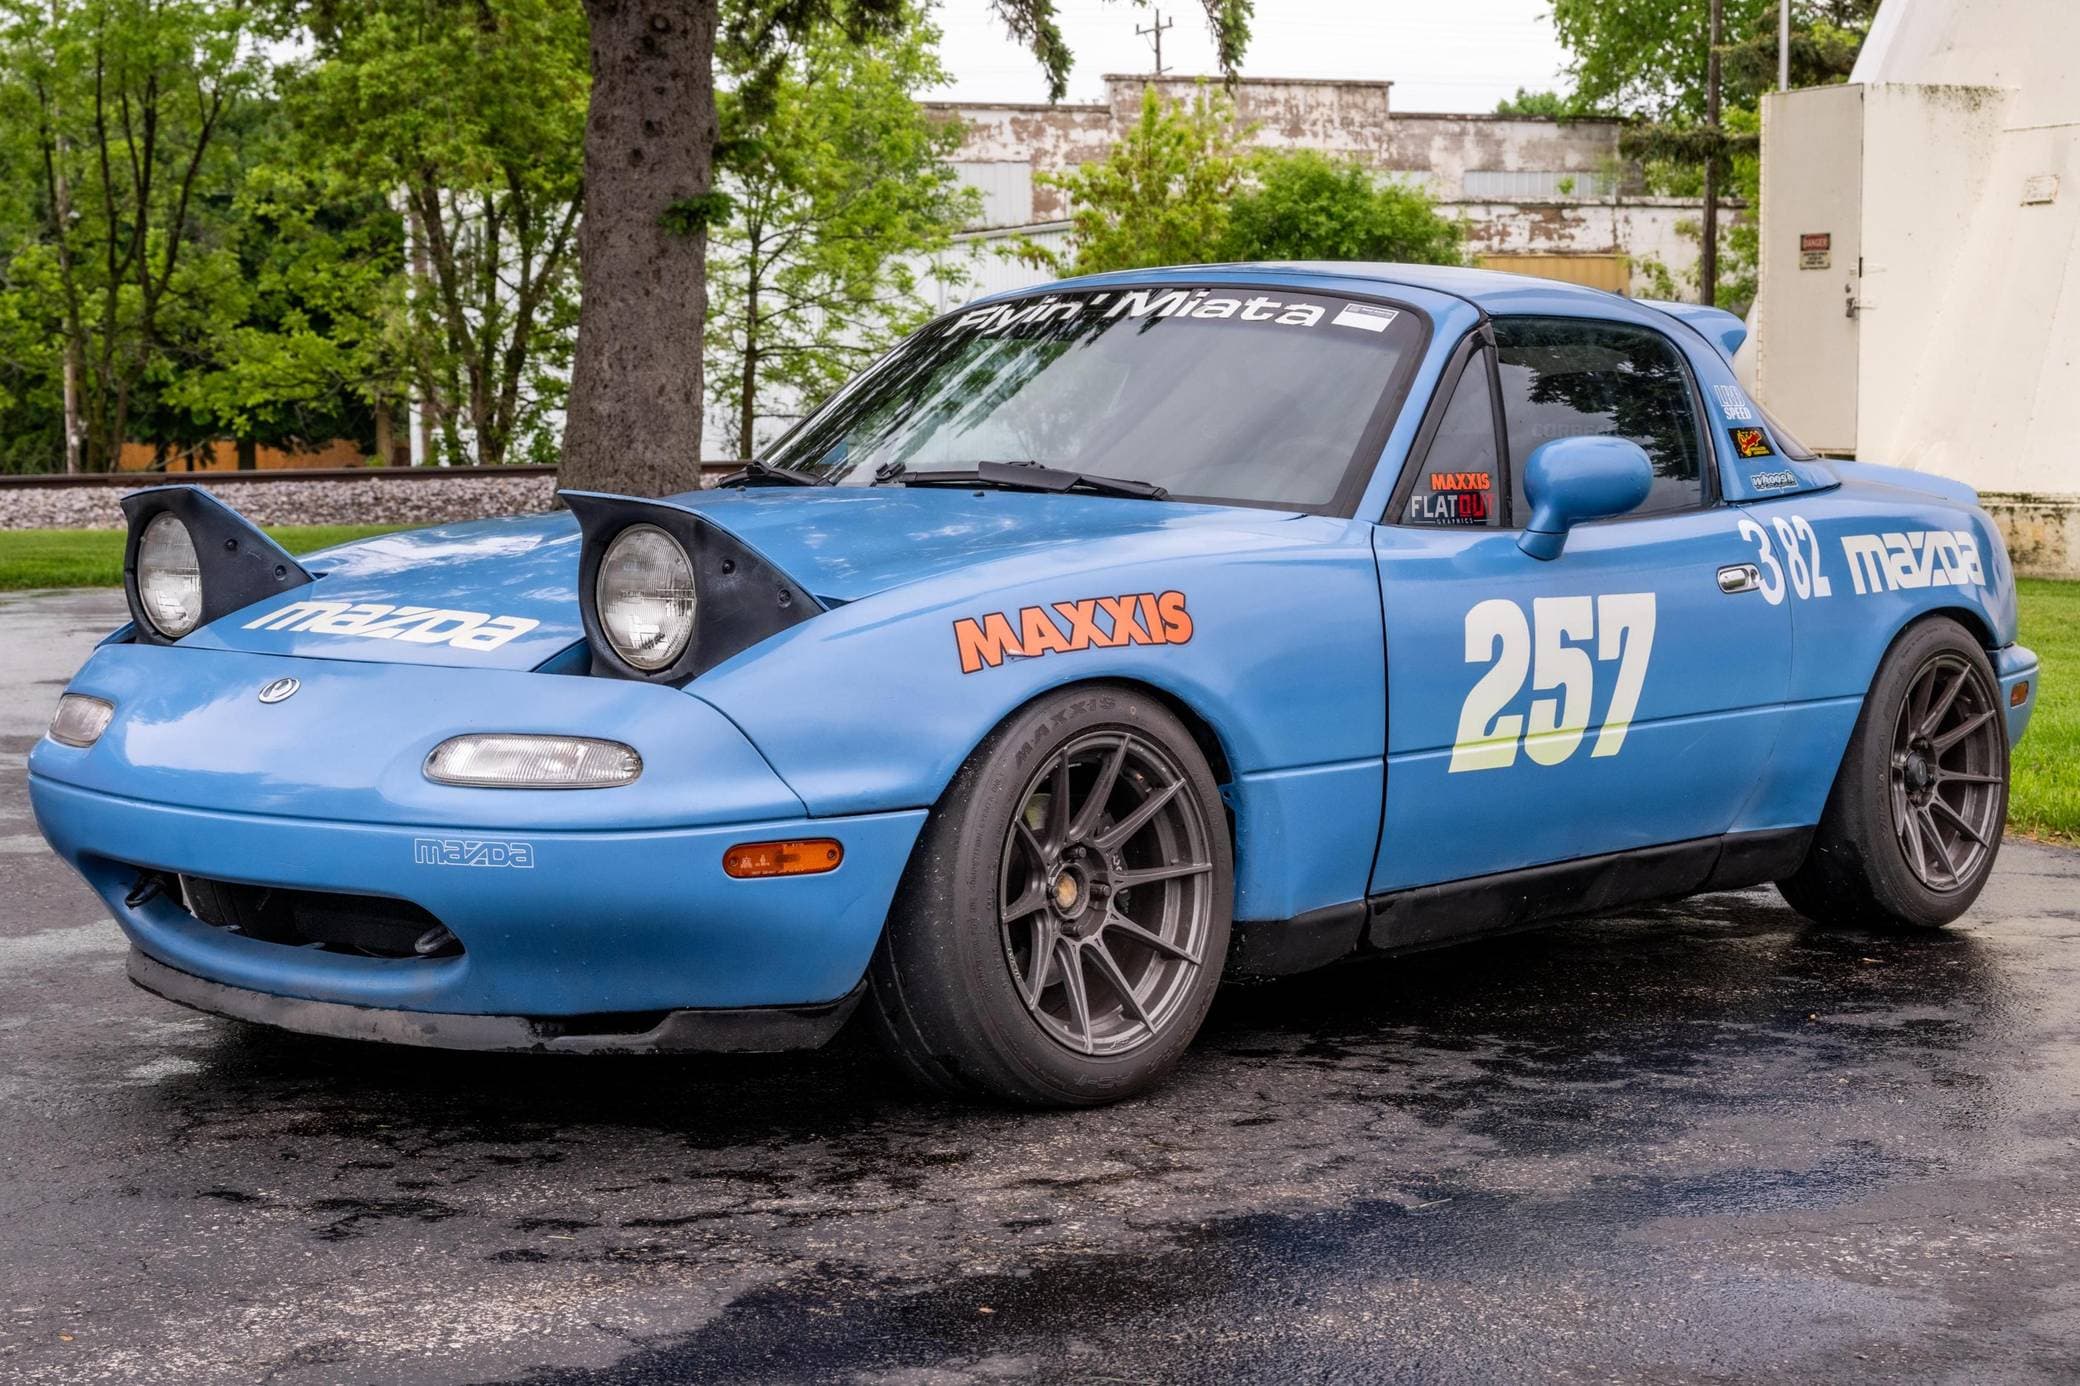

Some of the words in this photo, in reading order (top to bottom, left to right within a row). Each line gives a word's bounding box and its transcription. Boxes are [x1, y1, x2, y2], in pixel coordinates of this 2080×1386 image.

[942, 293, 1112, 337] Flyin'
[1103, 290, 1326, 327] Miata
[1724, 406, 1752, 420] SPEED
[1430, 472, 1491, 491] MAXXIS
[953, 590, 1193, 674] MAXXIS
[1448, 592, 1657, 773] 257
